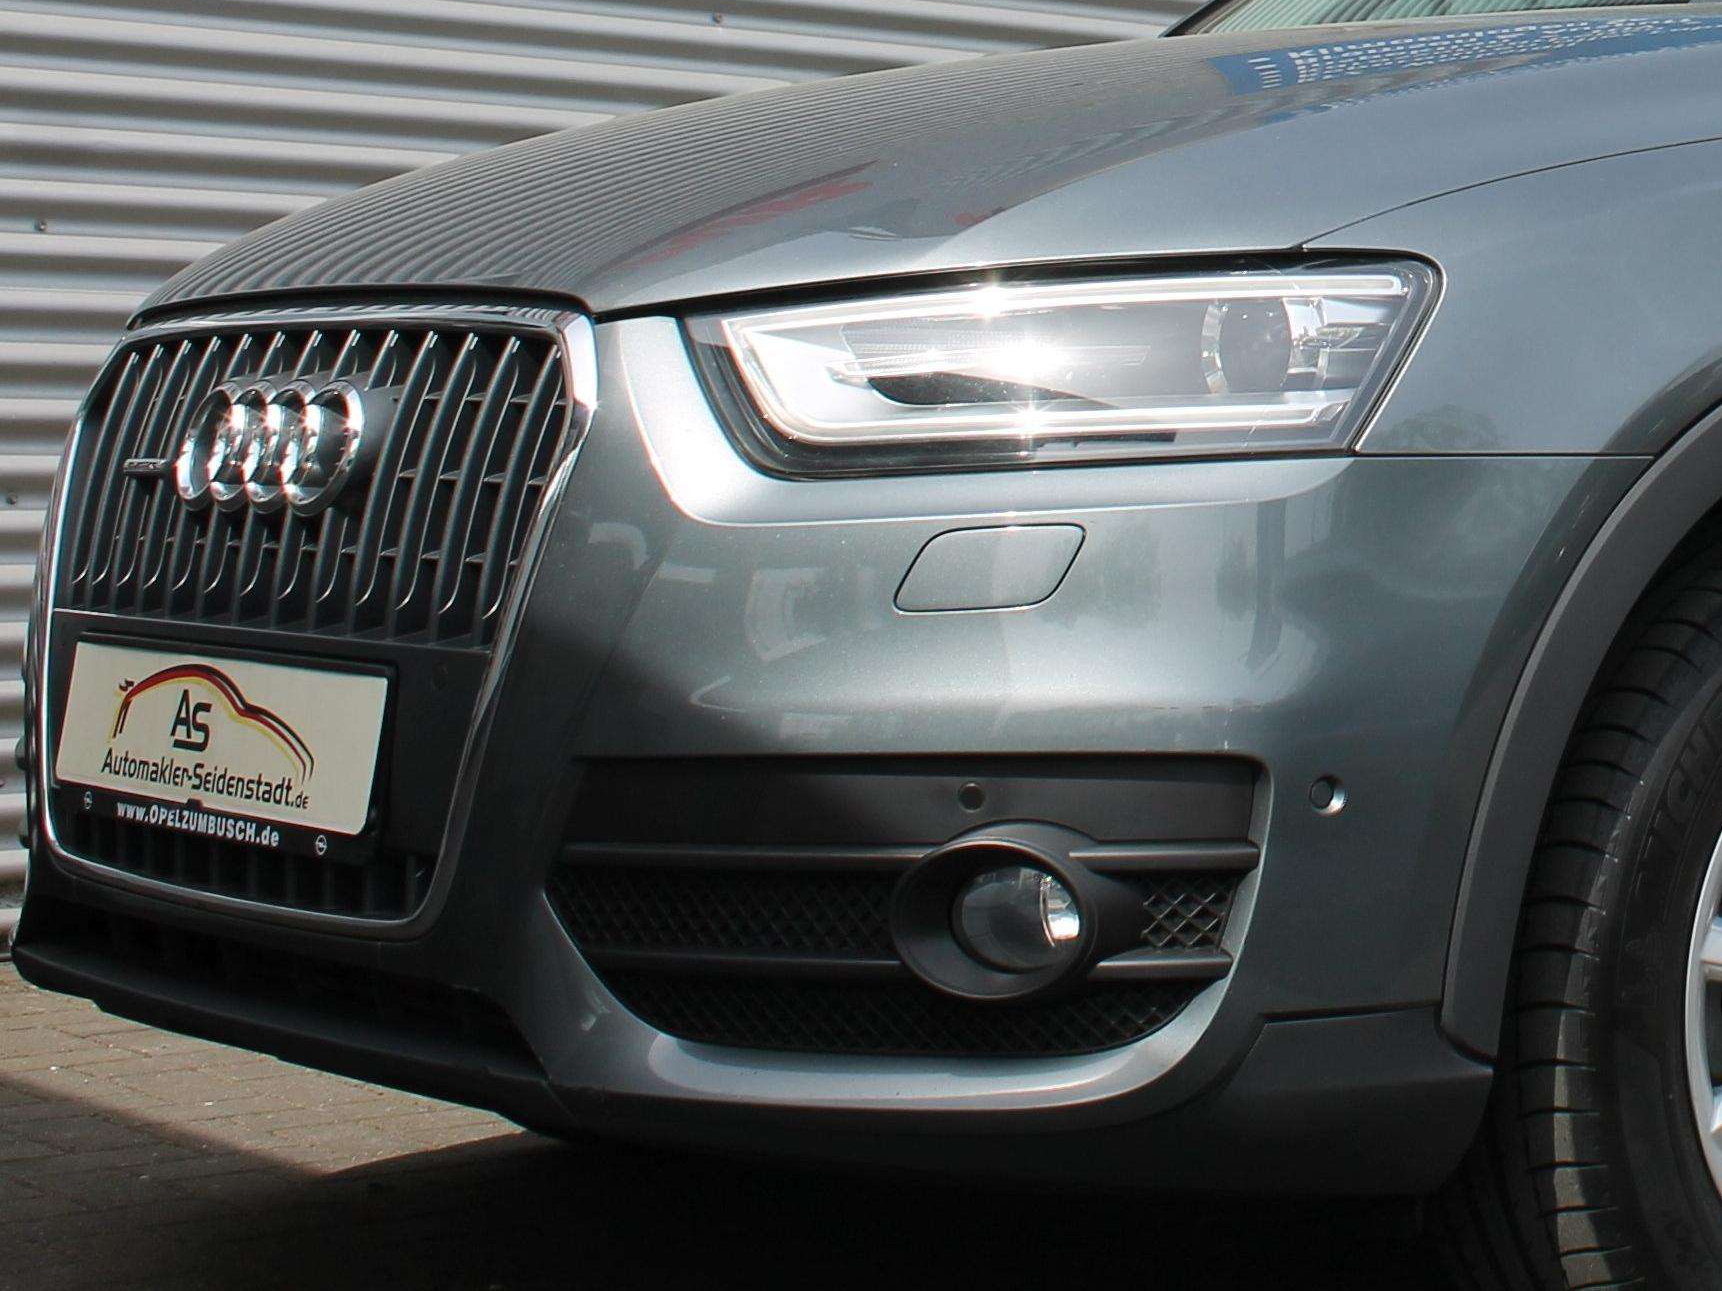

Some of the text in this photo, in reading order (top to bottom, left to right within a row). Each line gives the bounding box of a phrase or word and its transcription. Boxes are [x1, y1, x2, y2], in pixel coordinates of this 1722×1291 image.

[170, 688, 212, 752] AS
[100, 747, 309, 810] Automakler-Seidenstadt.de
[116, 801, 280, 847] www.OPELZUMBUSCH.de
